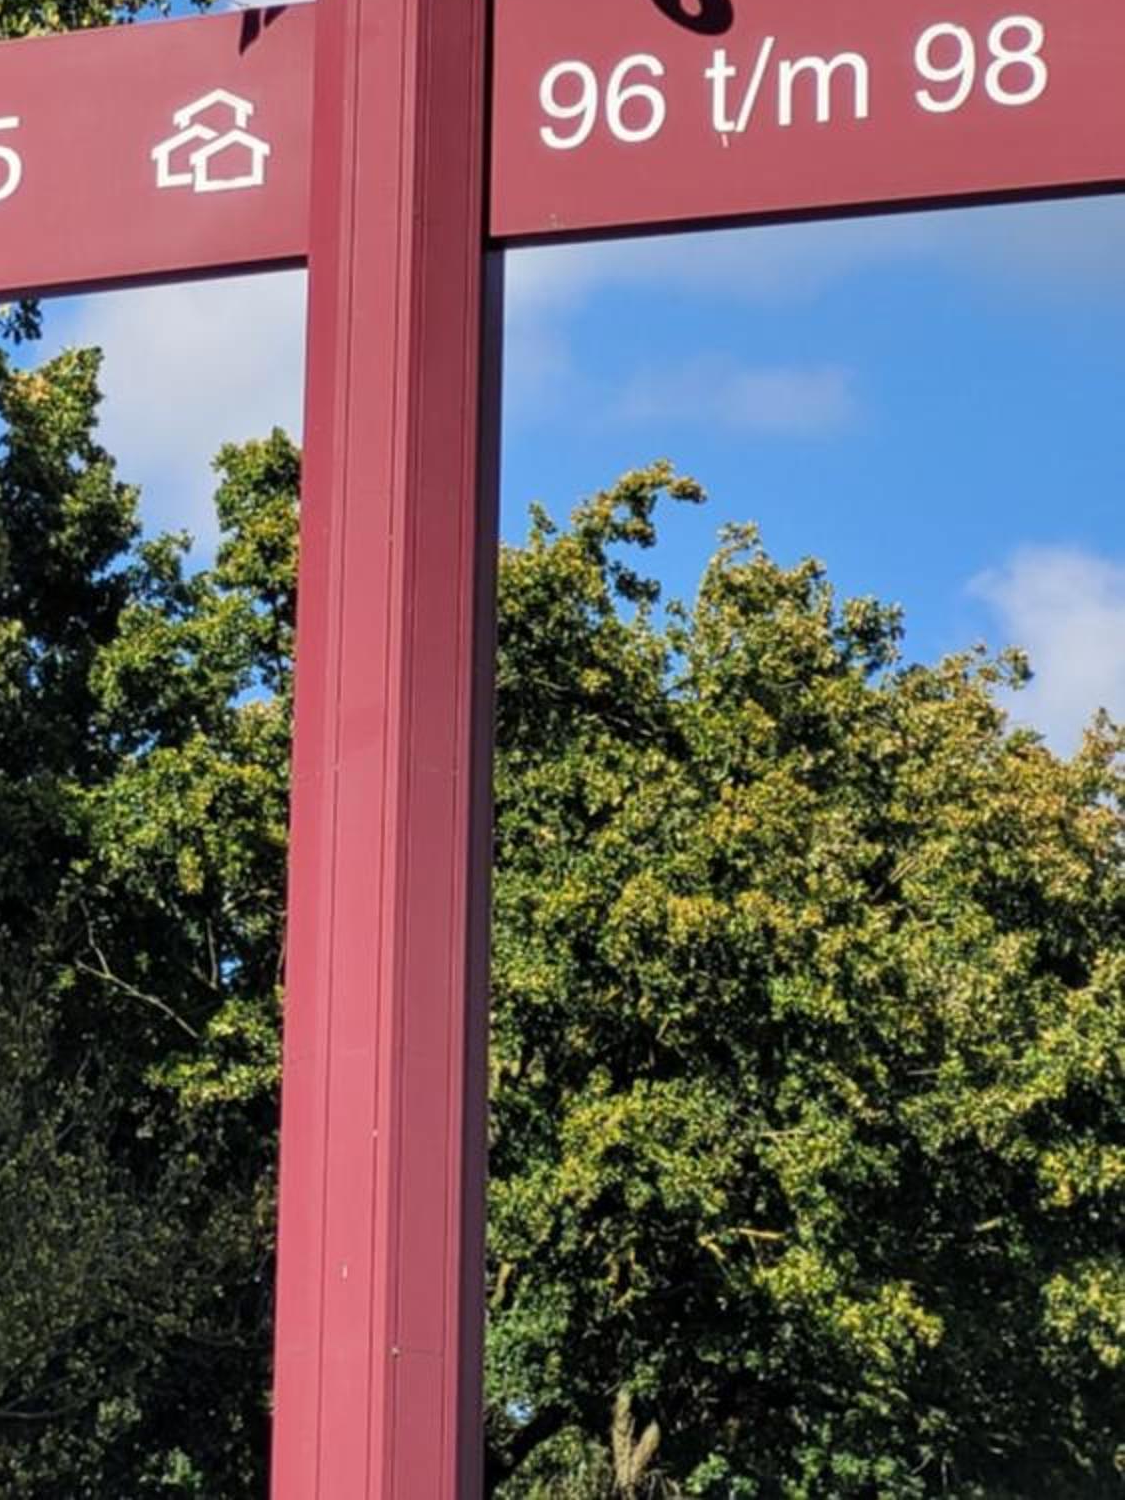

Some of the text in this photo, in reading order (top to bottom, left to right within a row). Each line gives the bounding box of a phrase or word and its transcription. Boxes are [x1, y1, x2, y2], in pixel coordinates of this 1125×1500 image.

[538, 14, 1049, 151] 96 t/m 98
